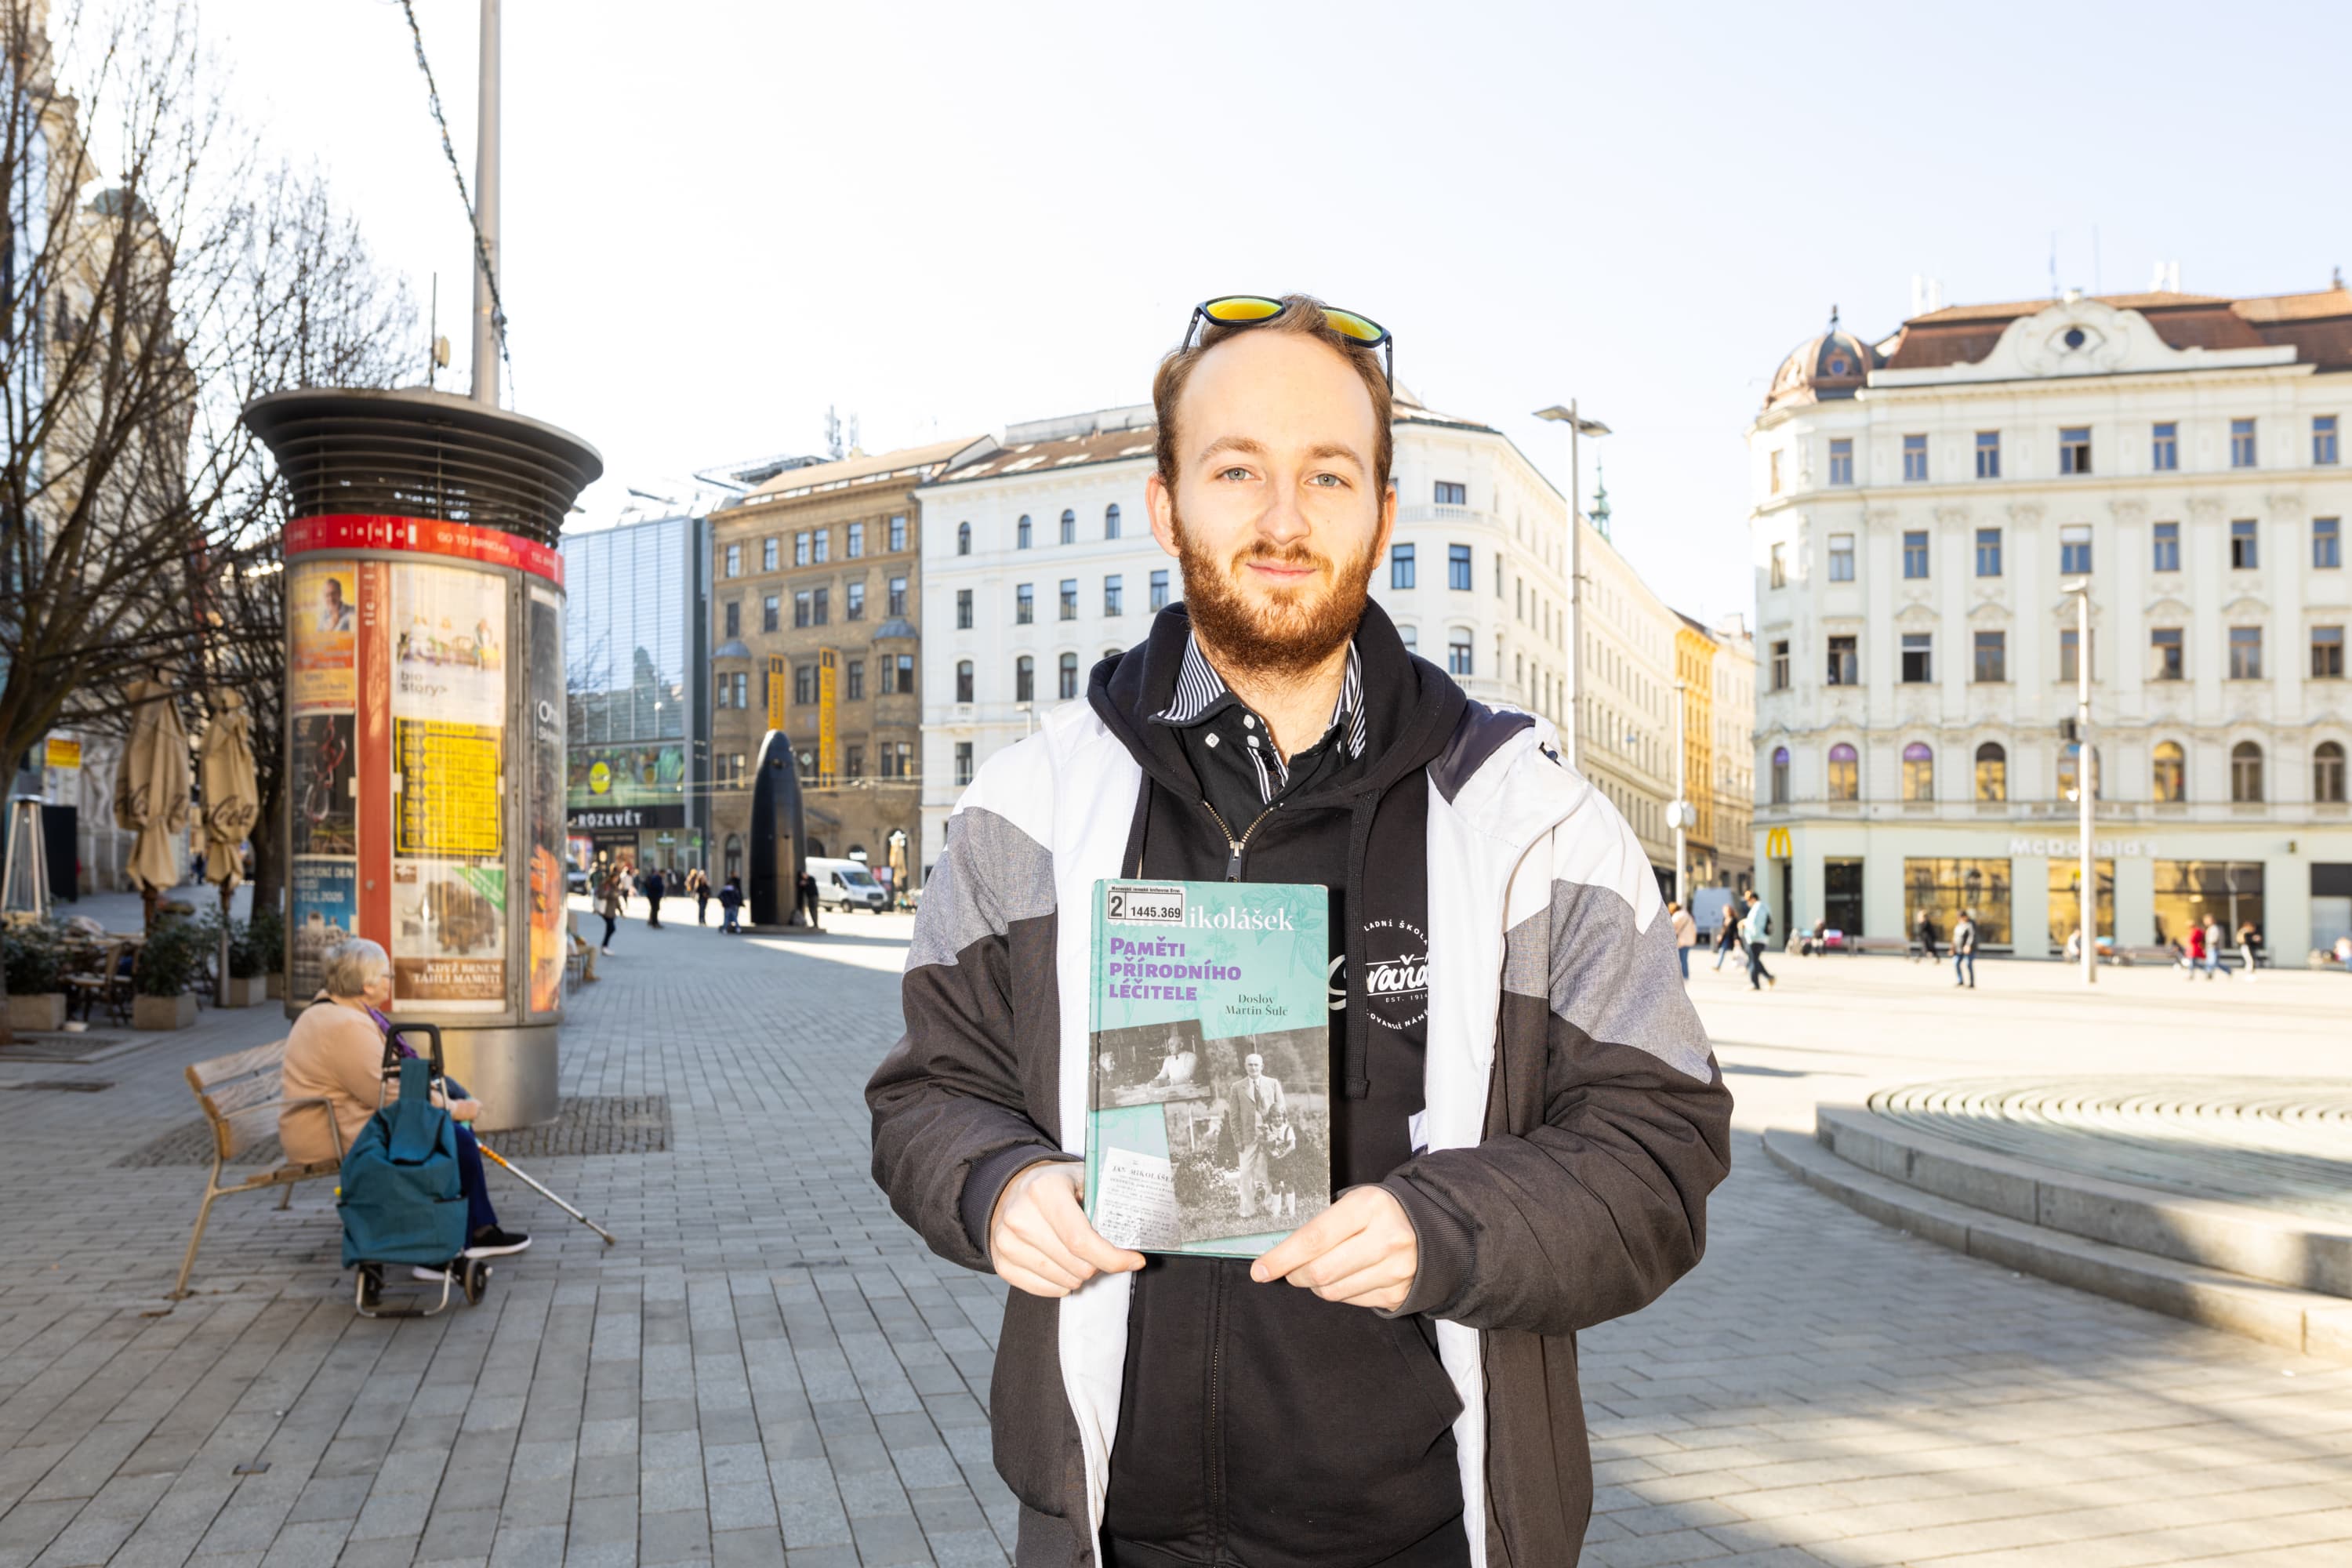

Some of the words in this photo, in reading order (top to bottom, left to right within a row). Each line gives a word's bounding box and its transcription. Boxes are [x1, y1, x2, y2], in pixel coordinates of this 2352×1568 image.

[578, 809, 642, 828] ROZKVĚT
[1110, 895, 1123, 917] 2
[1131, 906, 1181, 918] 1445.369
[1176, 905, 1294, 931] ikolášek
[1109, 935, 1185, 957] PAMĚTI
[452, 974, 500, 985] MAMUTI
[1109, 956, 1242, 981] PŘÍRODNÍHO
[1109, 978, 1198, 1001] LÉČITELE
[1238, 993, 1275, 1004] Doslov
[1225, 1004, 1262, 1016] Martin
[1265, 1004, 1288, 1017] Šulc
[1366, 1008, 1403, 1031] OVANSKÉ
